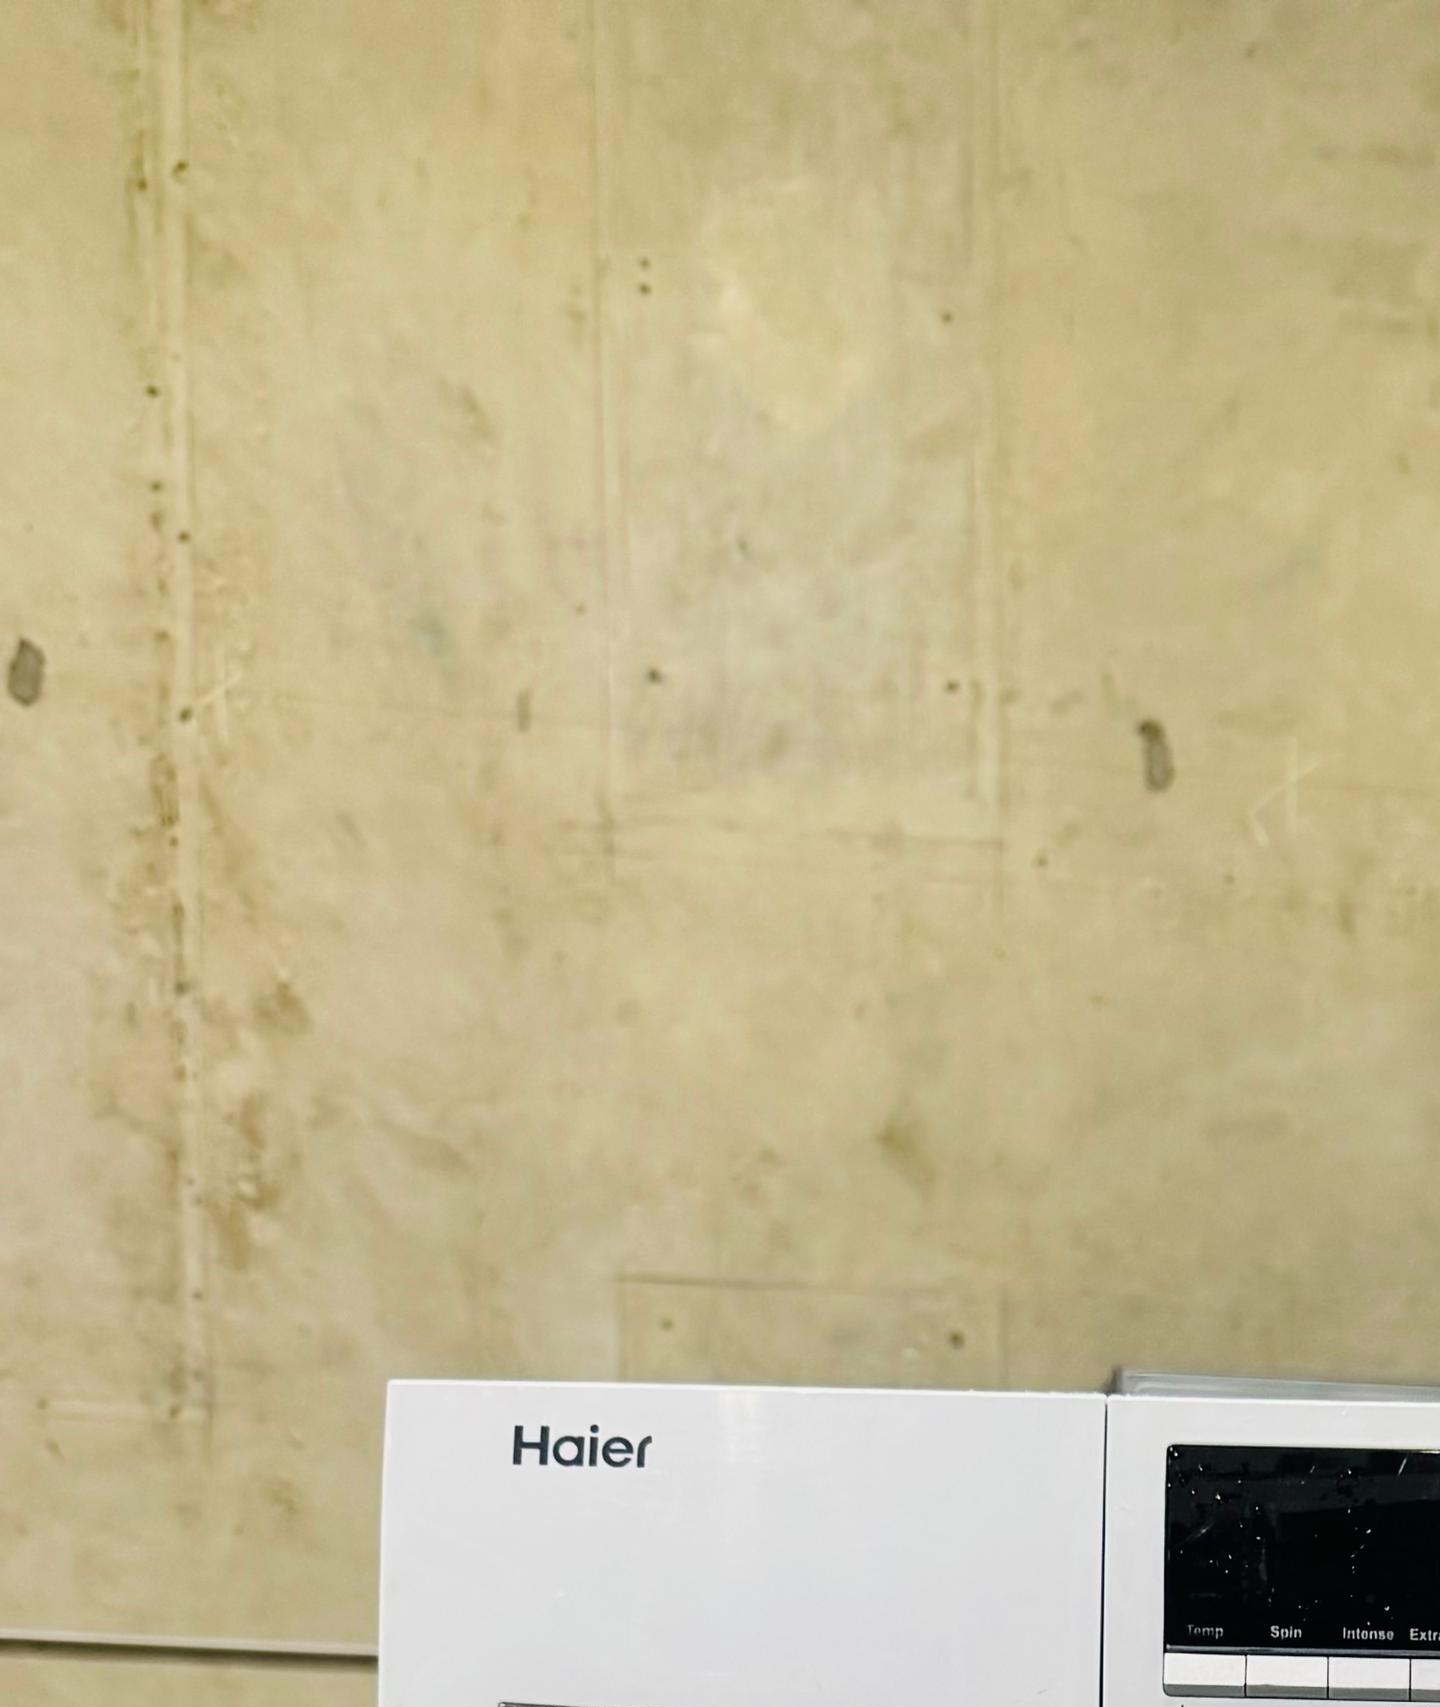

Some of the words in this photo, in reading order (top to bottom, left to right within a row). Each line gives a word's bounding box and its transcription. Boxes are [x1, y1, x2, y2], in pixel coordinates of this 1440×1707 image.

[512, 1424, 653, 1468] Haier
[1187, 1624, 1224, 1639] Temp
[1270, 1625, 1302, 1640] Spin
[1343, 1626, 1394, 1641] Intense
